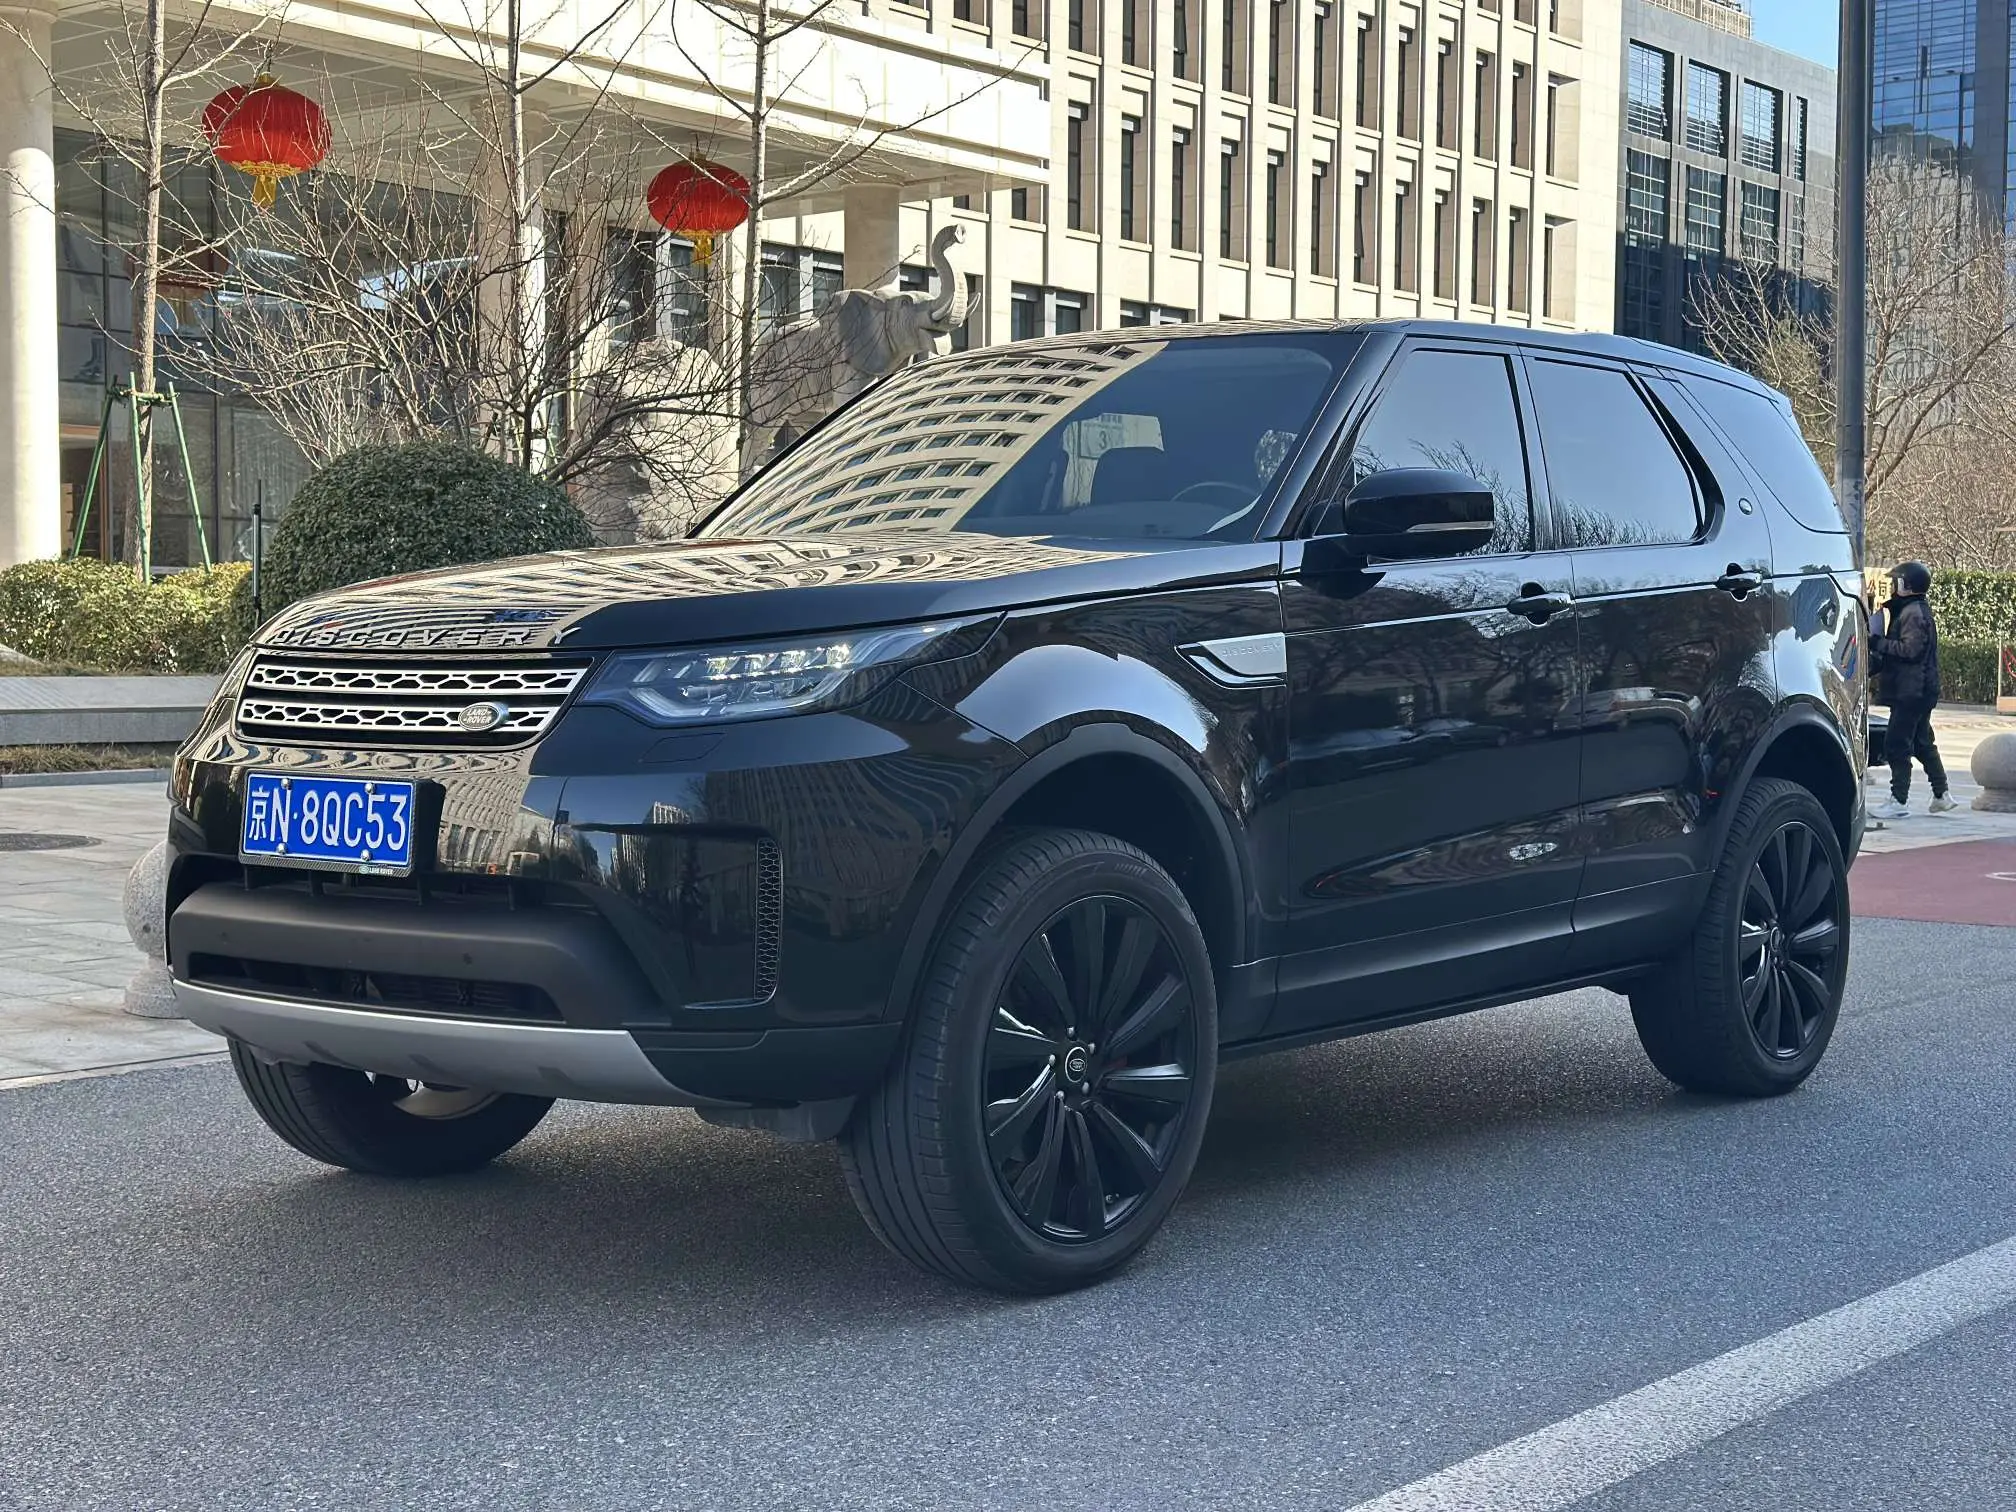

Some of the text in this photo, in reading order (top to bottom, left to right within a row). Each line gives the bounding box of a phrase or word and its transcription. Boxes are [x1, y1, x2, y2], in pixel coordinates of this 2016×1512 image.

[273, 627, 579, 646] DISCOVERY
[466, 708, 489, 716] LAND
[465, 716, 492, 724] ROVER
